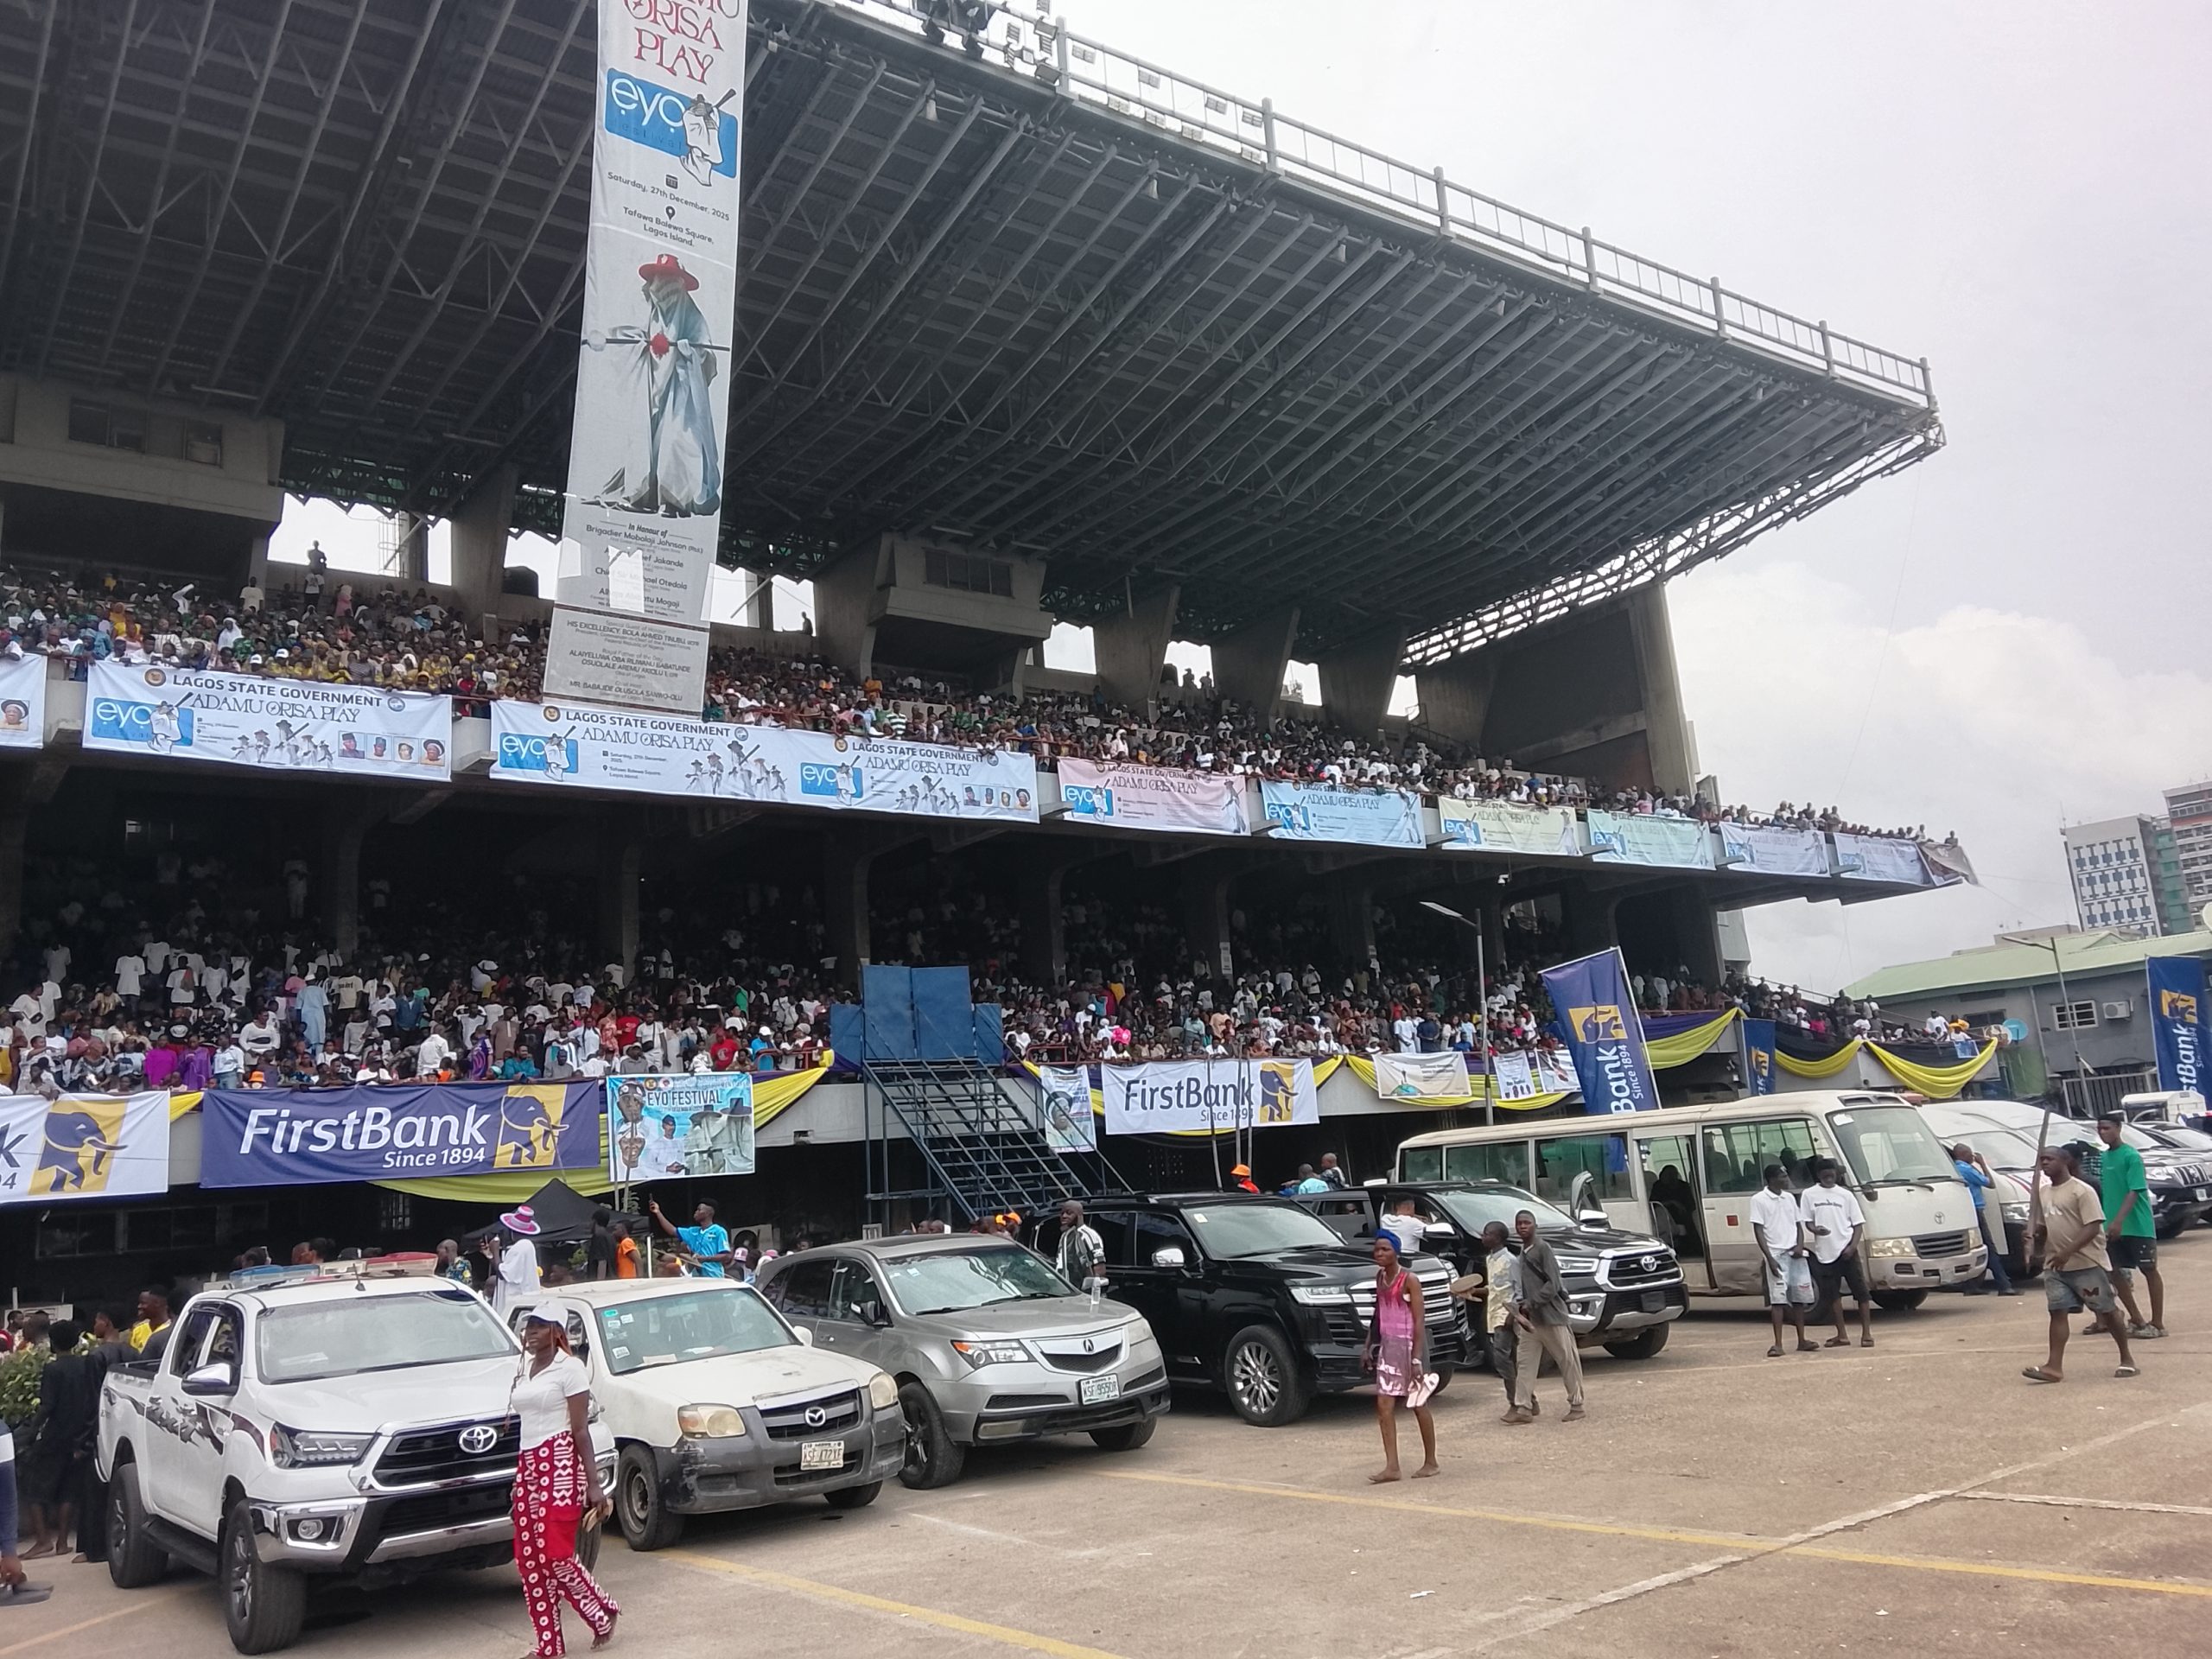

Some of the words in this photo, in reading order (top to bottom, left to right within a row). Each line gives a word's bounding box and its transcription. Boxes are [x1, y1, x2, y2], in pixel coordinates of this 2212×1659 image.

[634, 27, 715, 85] PLAY
[607, 172, 648, 194] Saturday,
[651, 187, 668, 199] 27th
[711, 207, 730, 221] 2025
[623, 206, 653, 223] Tafawa
[655, 216, 683, 234] Balewa
[644, 222, 669, 239] Lagos
[586, 524, 622, 537] Brigadier
[624, 531, 656, 546] Mobolaji
[657, 538, 687, 551] Johnson
[628, 523, 635, 531] In
[636, 524, 659, 537] Honour
[660, 529, 668, 539] of
[653, 556, 683, 569] Jakande
[658, 578, 688, 590] Otedola
[656, 596, 680, 609] Mogaji
[621, 627, 640, 637] BOLA
[611, 655, 626, 664] OBA
[173, 674, 225, 691] LAGOS
[227, 680, 276, 697] STATE
[279, 686, 382, 708] GOVERNMENT
[189, 693, 264, 715] ADAMU
[265, 698, 319, 720] ORISA
[321, 705, 360, 723] PLAY
[566, 710, 607, 725] LAGOS
[609, 715, 648, 729] STATE
[650, 719, 731, 737] GOVERNMENT
[581, 728, 639, 744] ADAMU
[639, 732, 681, 749] ORISA
[683, 735, 715, 752] PLAY
[852, 741, 886, 754] LAGOS
[887, 745, 917, 757] STATE
[918, 747, 984, 763] GOVERNMENT
[946, 763, 972, 777] PLAY
[1108, 765, 1132, 775] LAGOS
[1132, 766, 1154, 777] STATE
[1619, 1044, 1635, 1069] 1894
[1124, 1077, 1255, 1112] FirstBank
[1632, 1071, 1643, 1100] Since
[647, 1091, 669, 1106] EYO
[671, 1089, 722, 1105] FESTIVAL
[1200, 1109, 1228, 1122] Since
[239, 1104, 492, 1154] FirstBank
[383, 1150, 435, 1168] Since
[442, 1147, 486, 1165] 1894
